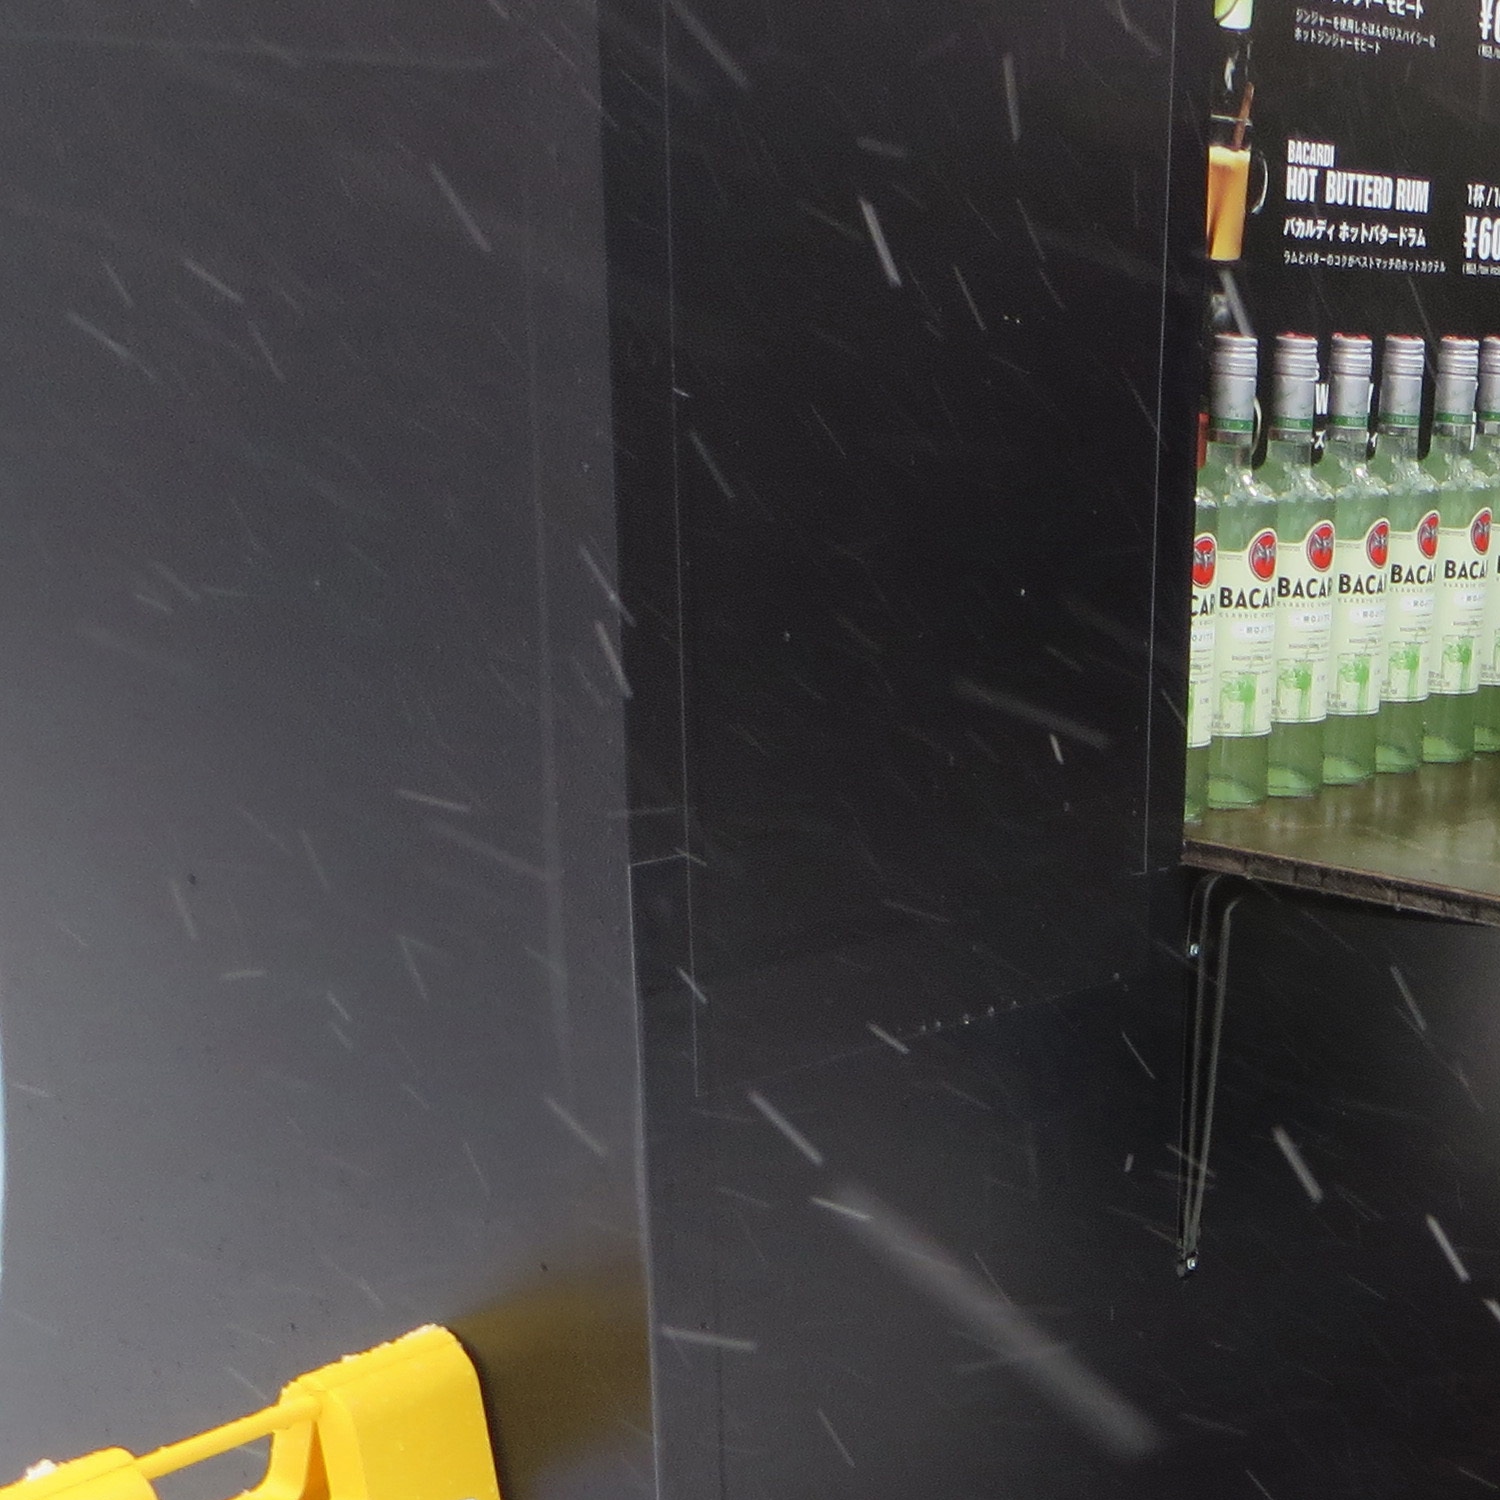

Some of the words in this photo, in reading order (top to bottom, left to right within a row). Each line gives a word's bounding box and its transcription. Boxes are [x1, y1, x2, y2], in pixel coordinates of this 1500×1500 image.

[1294, 27, 1382, 54] ホットジンジャーモヒート
[1287, 139, 1335, 168] BACARDI
[1286, 165, 1318, 202] HOT
[1325, 170, 1394, 210] BUTTERD
[1395, 178, 1430, 213] RUM
[1283, 216, 1336, 242] バカルディ
[1338, 221, 1427, 248] ホットバタードラム
